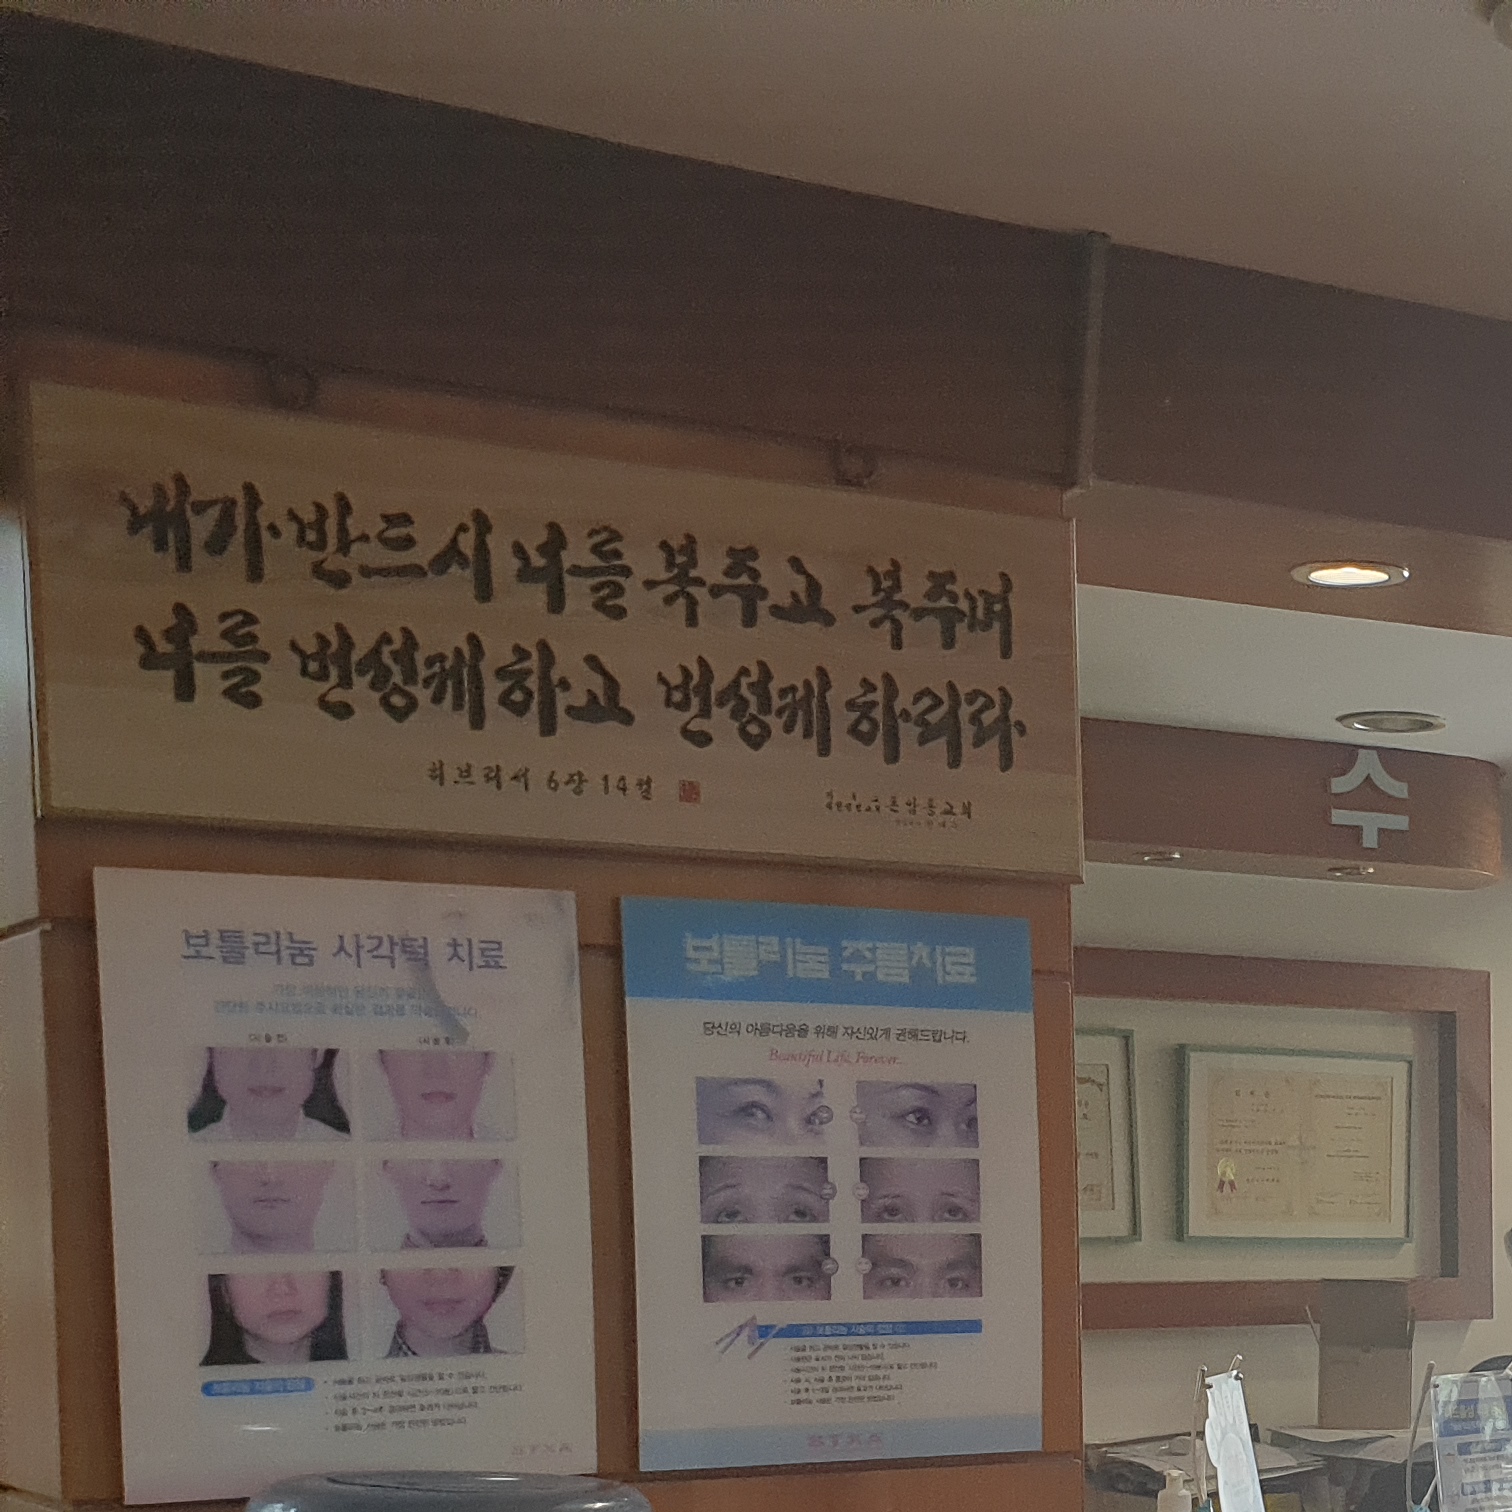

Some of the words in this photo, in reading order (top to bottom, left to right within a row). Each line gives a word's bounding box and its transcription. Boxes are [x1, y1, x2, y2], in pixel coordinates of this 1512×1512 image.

[119, 472, 282, 582] 내가
[287, 492, 494, 602] 반드시
[511, 521, 633, 620] 너를
[134, 602, 270, 709] 너를
[427, 759, 531, 791] 히브리서
[546, 769, 588, 796] 6장
[1331, 749, 1409, 849] 수
[181, 928, 317, 967] 보툴리눔
[446, 937, 508, 971] 치료
[840, 937, 978, 986] 주름치료
[702, 1021, 741, 1037] 당신의
[745, 1022, 809, 1040] 아름다움을
[813, 1024, 838, 1040] 위해
